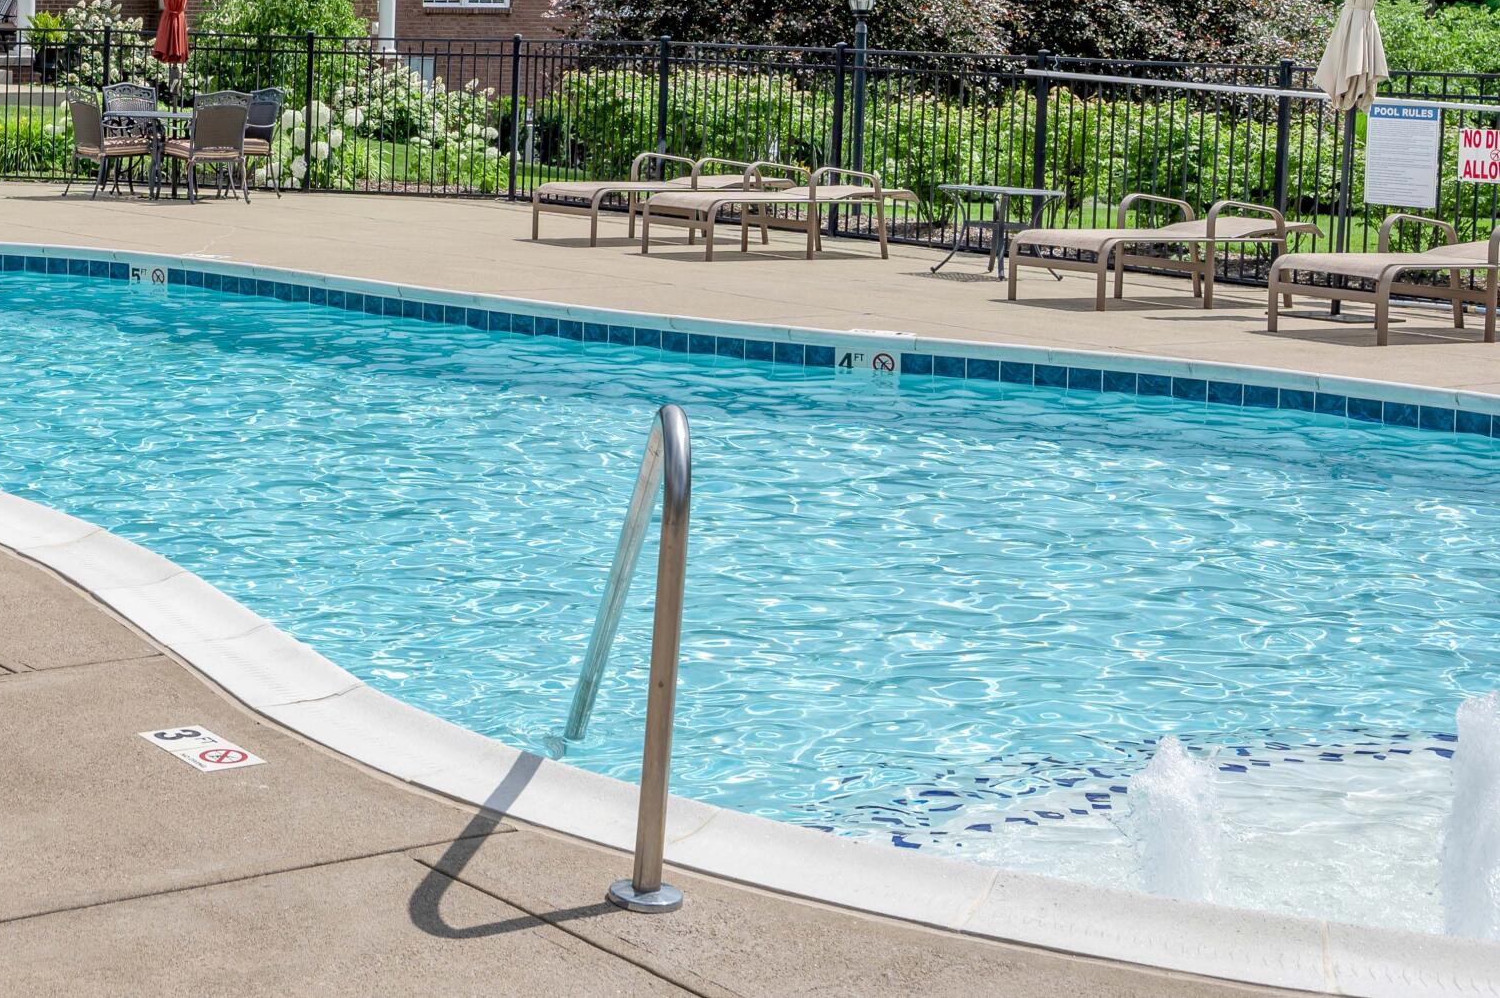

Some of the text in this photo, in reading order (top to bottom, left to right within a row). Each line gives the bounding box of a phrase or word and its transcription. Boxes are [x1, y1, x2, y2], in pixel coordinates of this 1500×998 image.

[1374, 106, 1434, 119] POOL RULES
[1463, 129, 1482, 149] NO
[1463, 159, 1500, 180] ALLO
[131, 267, 141, 284] 5
[838, 352, 865, 369] 4 FT
[154, 729, 202, 741] 3
